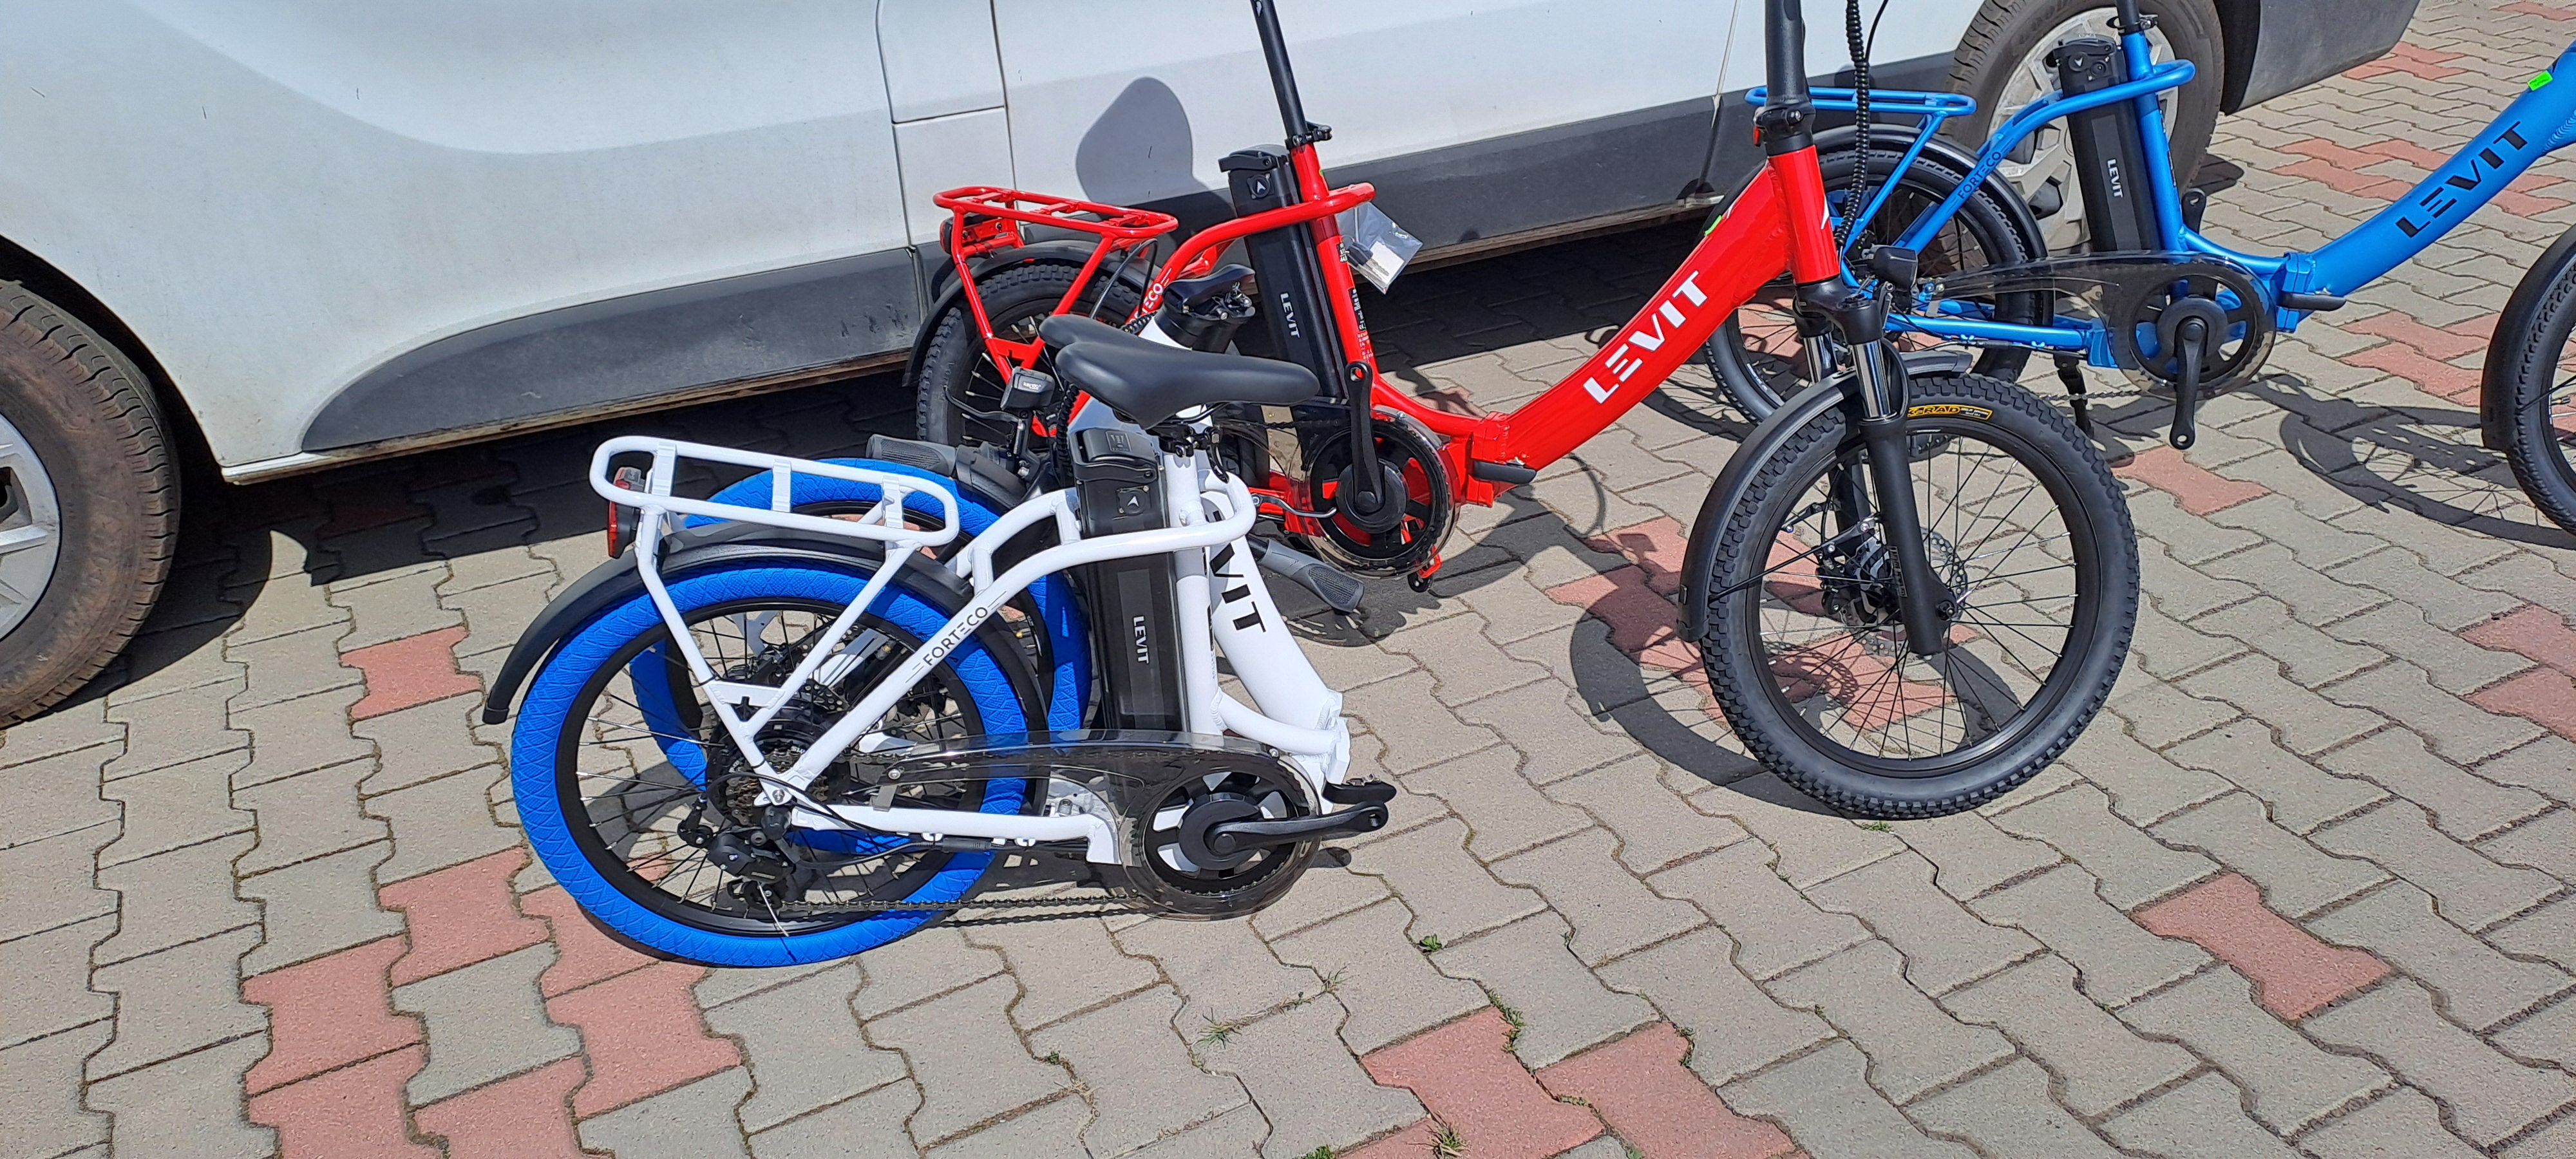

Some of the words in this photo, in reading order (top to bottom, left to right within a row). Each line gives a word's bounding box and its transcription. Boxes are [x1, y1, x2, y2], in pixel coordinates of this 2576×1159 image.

[1958, 151, 2002, 200] FORTECO
[2107, 158, 2123, 198] LEVIT
[2395, 120, 2528, 238] LEVIT
[1280, 292, 1300, 339] LEVIT
[1582, 269, 1708, 405] LEVIT
[1205, 511, 1267, 633] VIT
[922, 607, 988, 666] FORTECO
[1133, 616, 1150, 664] LEVIT
